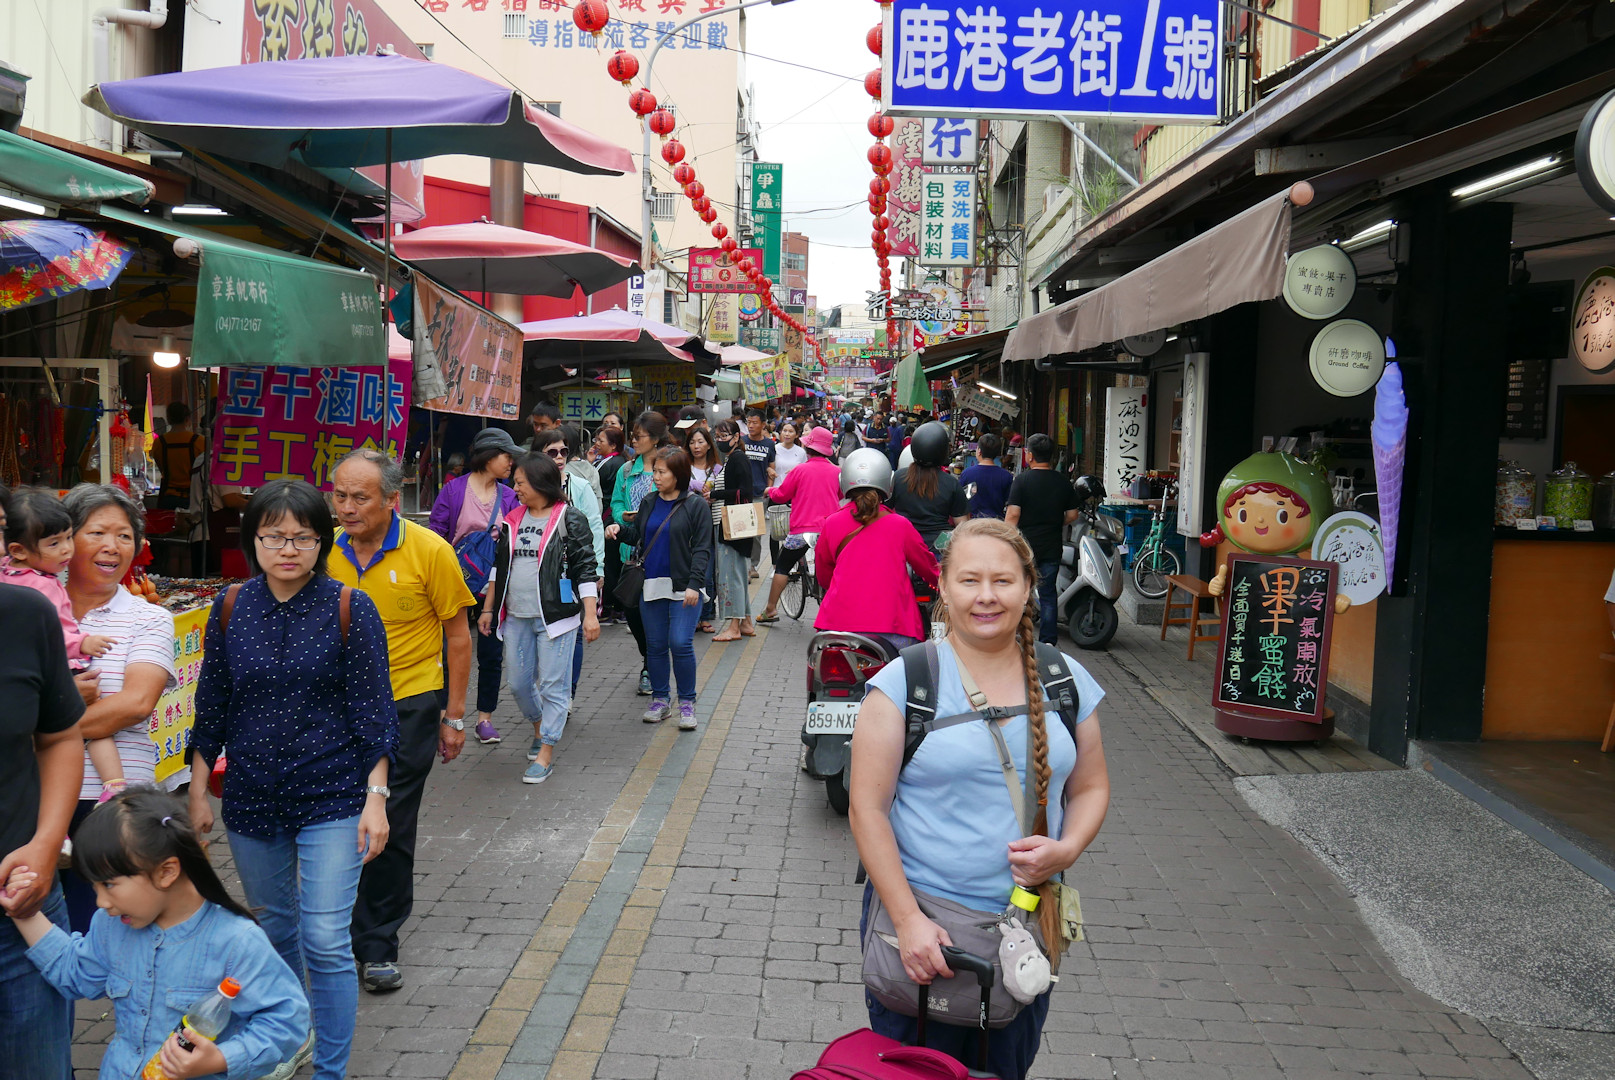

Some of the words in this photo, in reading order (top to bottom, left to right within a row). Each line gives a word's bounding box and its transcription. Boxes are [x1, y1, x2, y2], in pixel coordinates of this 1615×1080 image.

[896, 0, 1215, 101] 鹿港老街1號
[755, 163, 780, 171] OYSTER
[924, 180, 944, 260] 包裝材料
[950, 180, 971, 260] 免洗餐具
[632, 275, 643, 289] P
[1302, 283, 1336, 298] 專賣店
[215, 316, 263, 334] (04)7712167
[1327, 347, 1374, 363] 研磨咖啡
[1327, 359, 1349, 368] Ground
[1352, 362, 1370, 371] Coffee
[221, 365, 405, 430] 豆干滷味
[566, 396, 602, 418] 玉米
[218, 425, 399, 489] 手工梅
[744, 443, 769, 454] RMANI
[1117, 396, 1143, 489] 麻油之家
[1227, 576, 1252, 681] 全面買千送百
[1292, 587, 1326, 689] 冷氣開放
